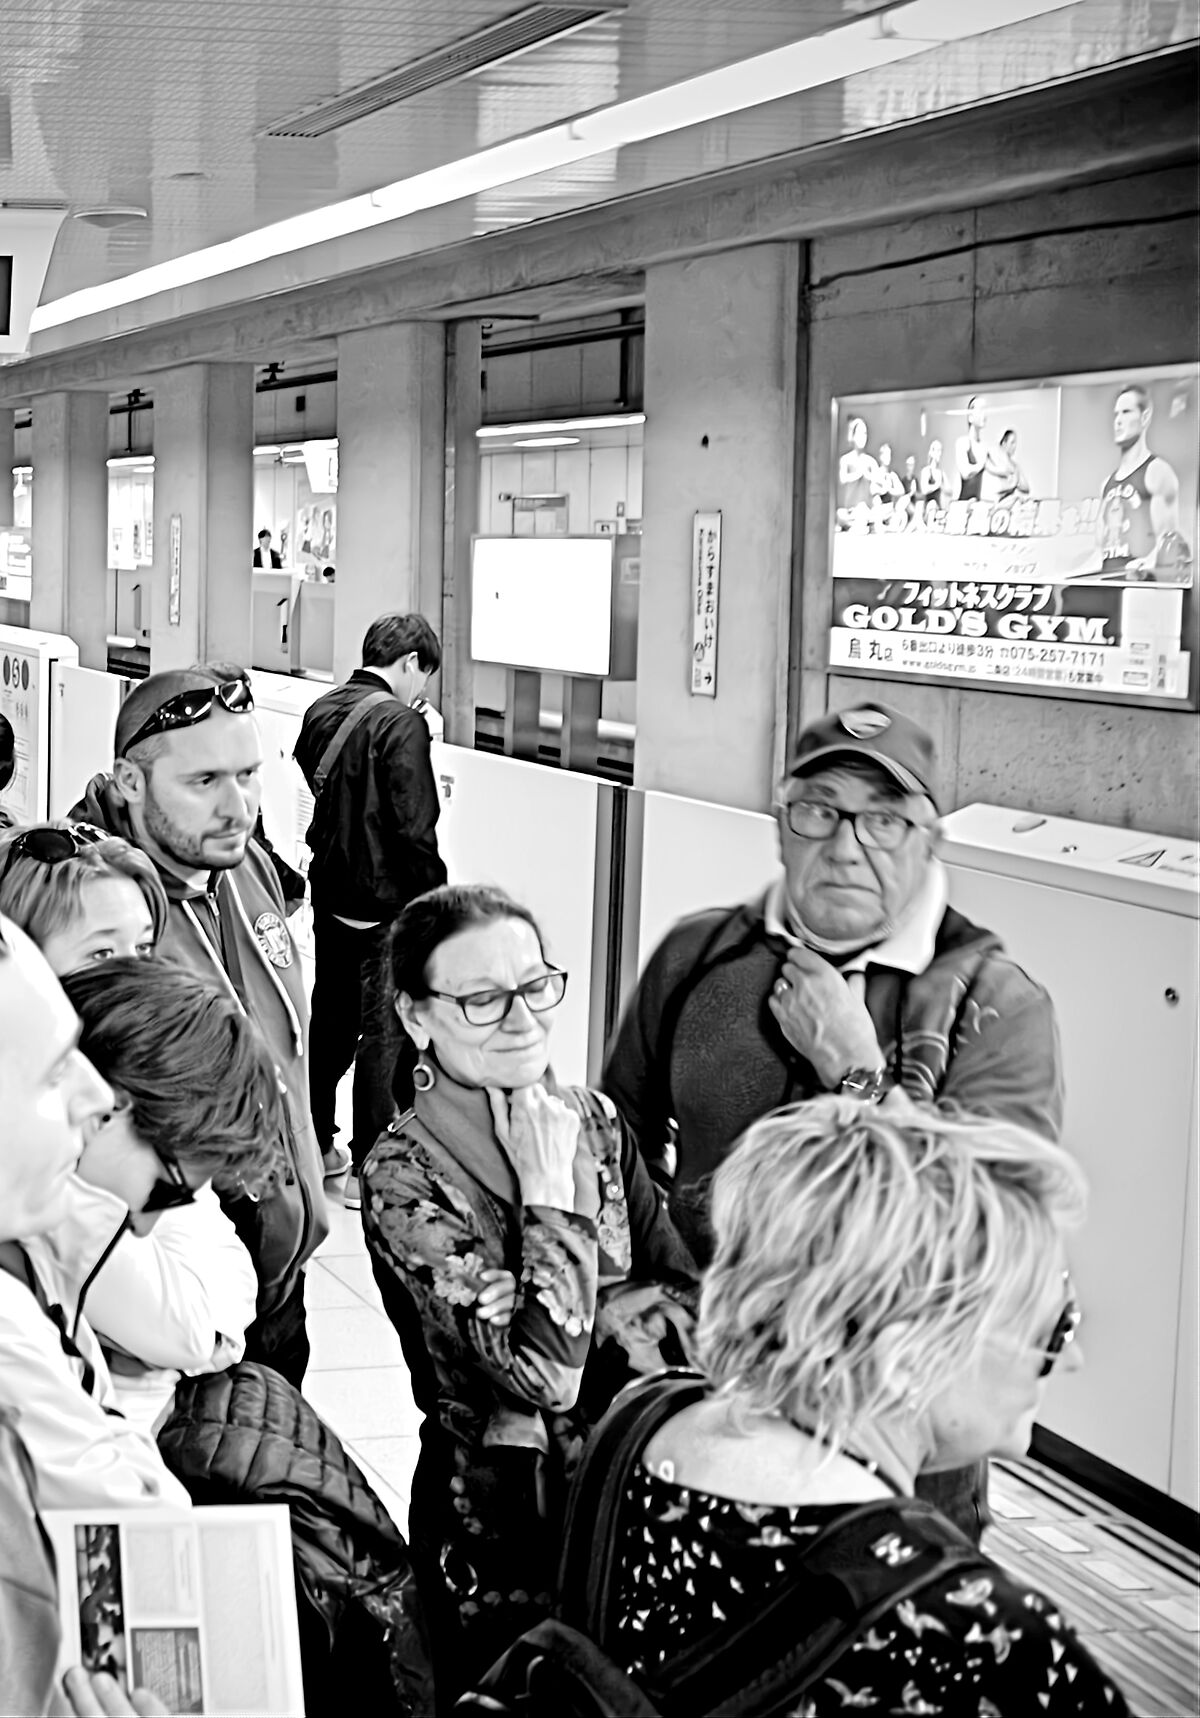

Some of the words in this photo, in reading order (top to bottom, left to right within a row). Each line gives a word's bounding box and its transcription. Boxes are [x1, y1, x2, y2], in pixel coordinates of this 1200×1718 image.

[903, 582, 1053, 612] フィットネスクラブ
[842, 604, 988, 637] GOLD'S
